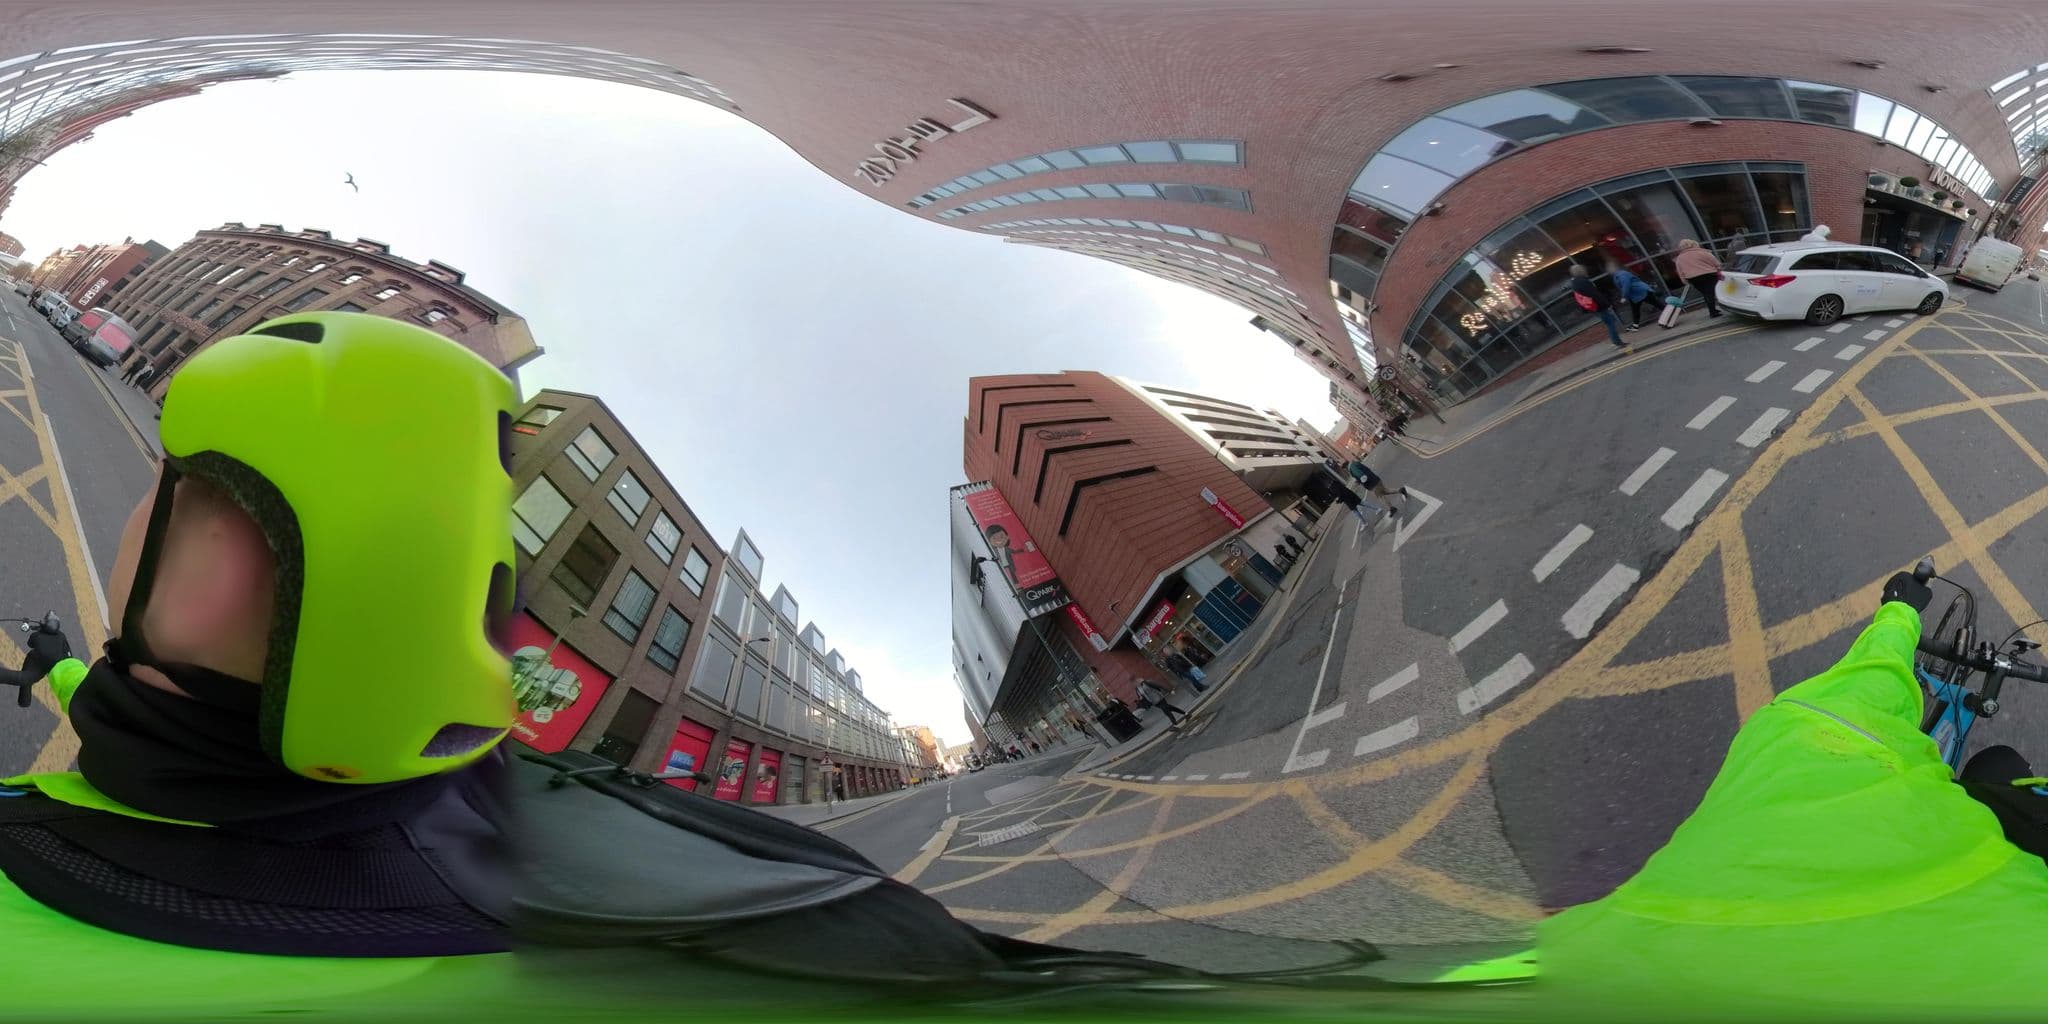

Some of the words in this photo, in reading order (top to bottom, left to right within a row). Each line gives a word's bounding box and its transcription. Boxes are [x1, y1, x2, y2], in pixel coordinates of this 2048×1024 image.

[854, 98, 996, 188] NOVOTEL
[1929, 167, 1967, 198] NOVOTEL
[1382, 367, 1394, 379] 20
[1217, 502, 1242, 527] bargains
[1070, 606, 1093, 633] bargains
[1146, 604, 1171, 632] bargains
